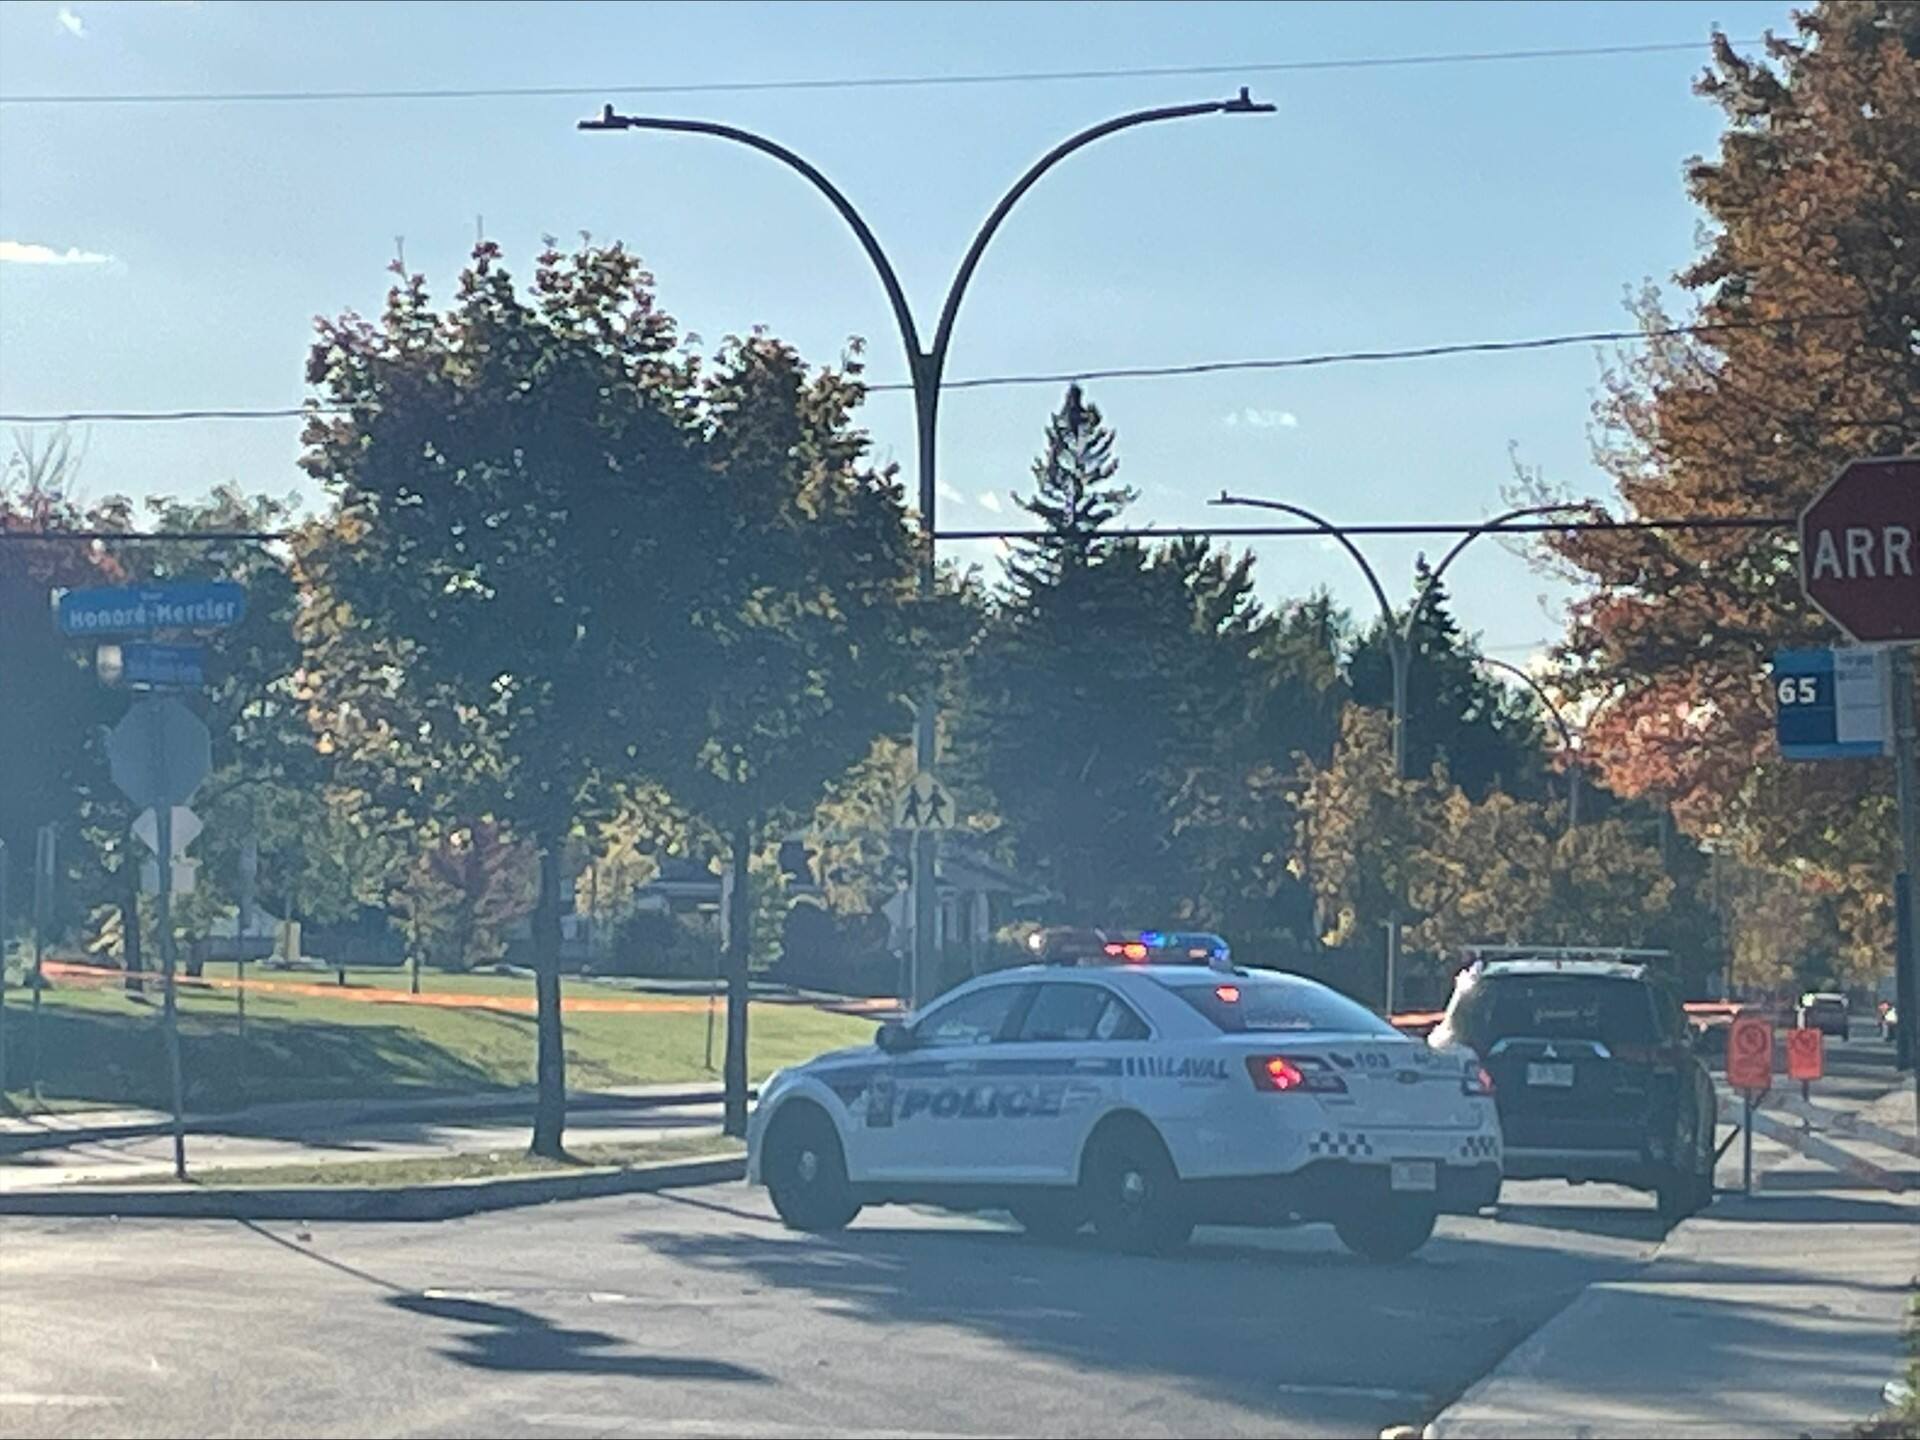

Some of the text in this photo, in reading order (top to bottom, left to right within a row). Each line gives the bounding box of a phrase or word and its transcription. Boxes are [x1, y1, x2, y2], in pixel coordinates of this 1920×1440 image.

[1778, 677, 1817, 704] 65
[1164, 1056, 1230, 1079] LAVAL
[898, 1085, 1067, 1119] POLICE
